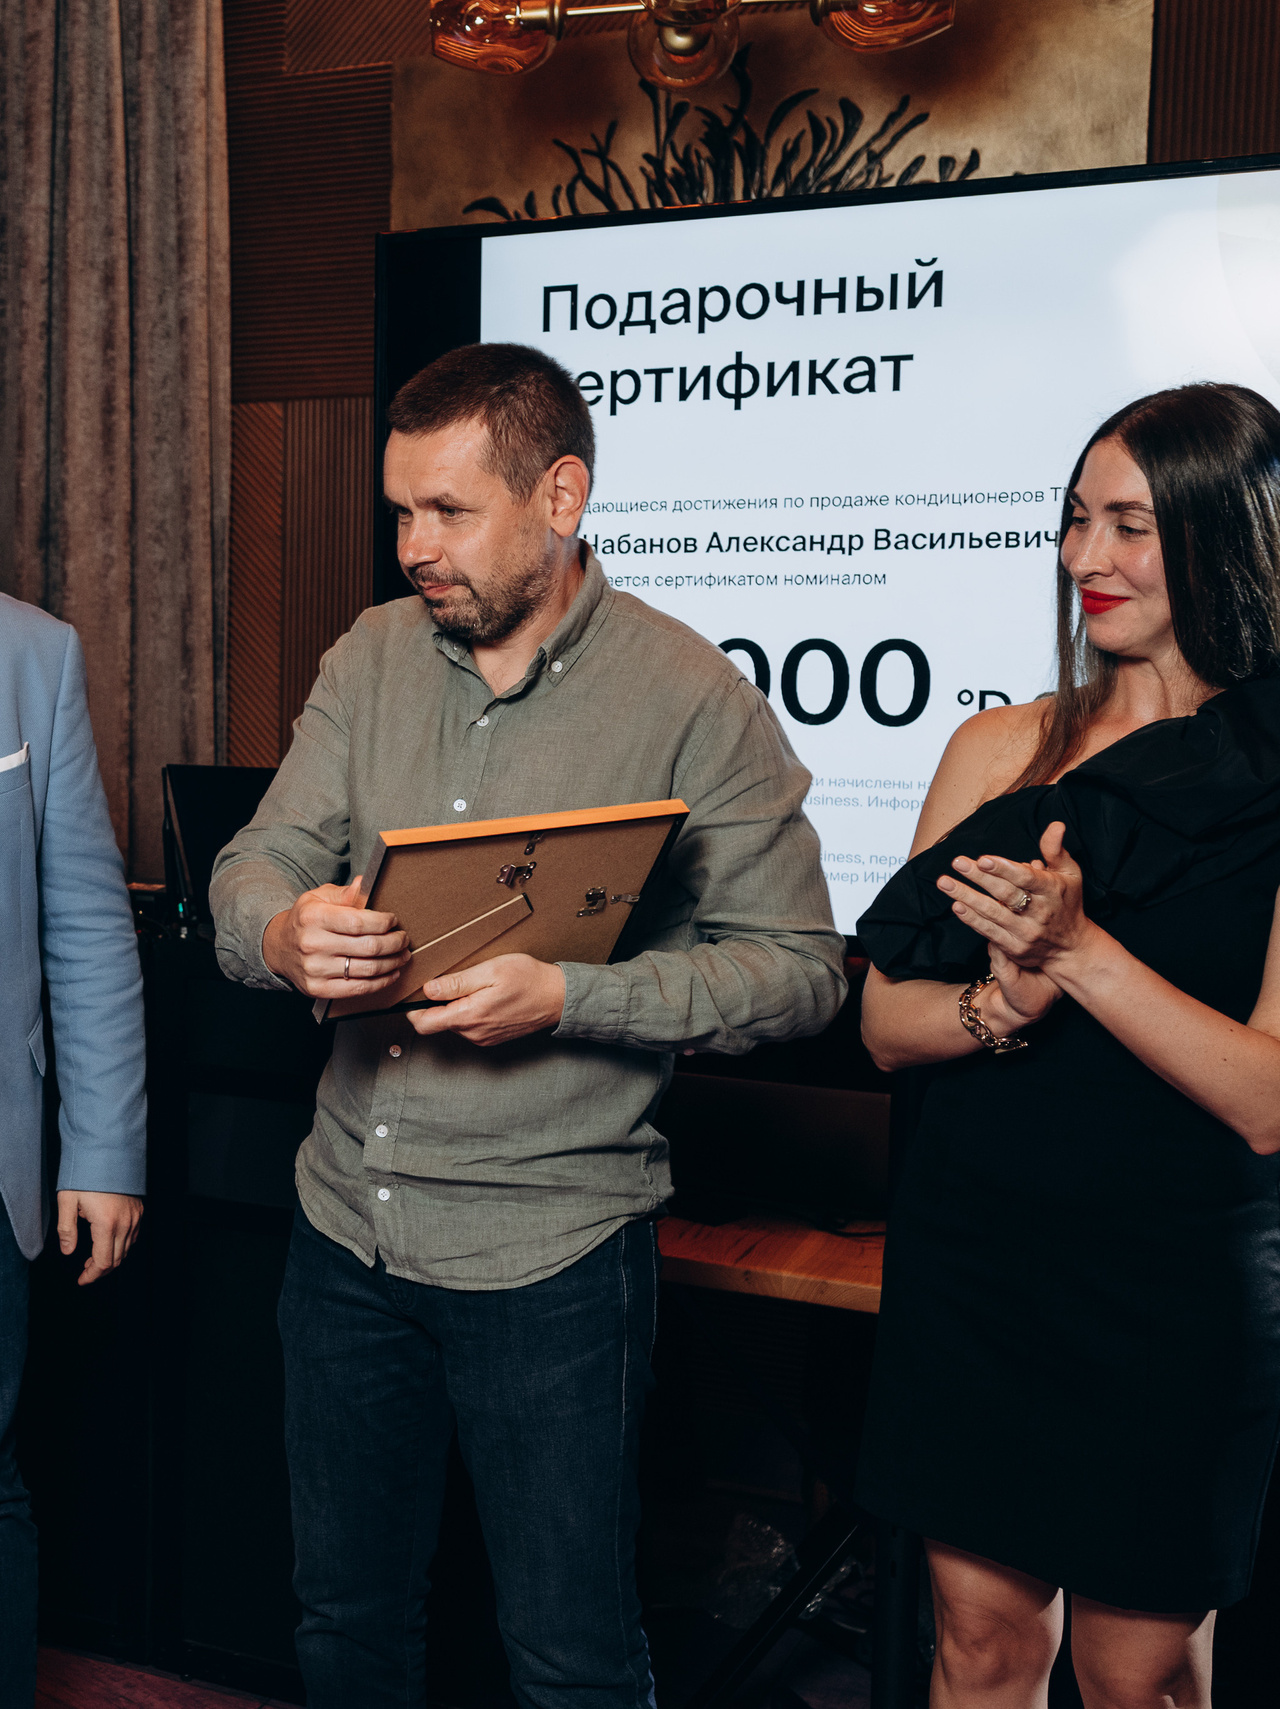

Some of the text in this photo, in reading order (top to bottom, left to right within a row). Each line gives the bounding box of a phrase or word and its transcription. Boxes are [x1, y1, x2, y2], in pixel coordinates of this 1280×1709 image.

[542, 257, 944, 336] Подарочный
[576, 350, 914, 417] ертификат
[584, 500, 668, 515] дающиеся
[671, 497, 778, 514] достижения
[783, 496, 805, 509] по
[809, 494, 890, 511] продаже
[894, 490, 1045, 508] кондиционеров
[705, 531, 865, 557] Александр
[873, 528, 1060, 551] Васильевич
[608, 572, 887, 590] ается сертификатом номиналом
[828, 777, 913, 790] начислены
[804, 793, 924, 812] usiness. Инфор
